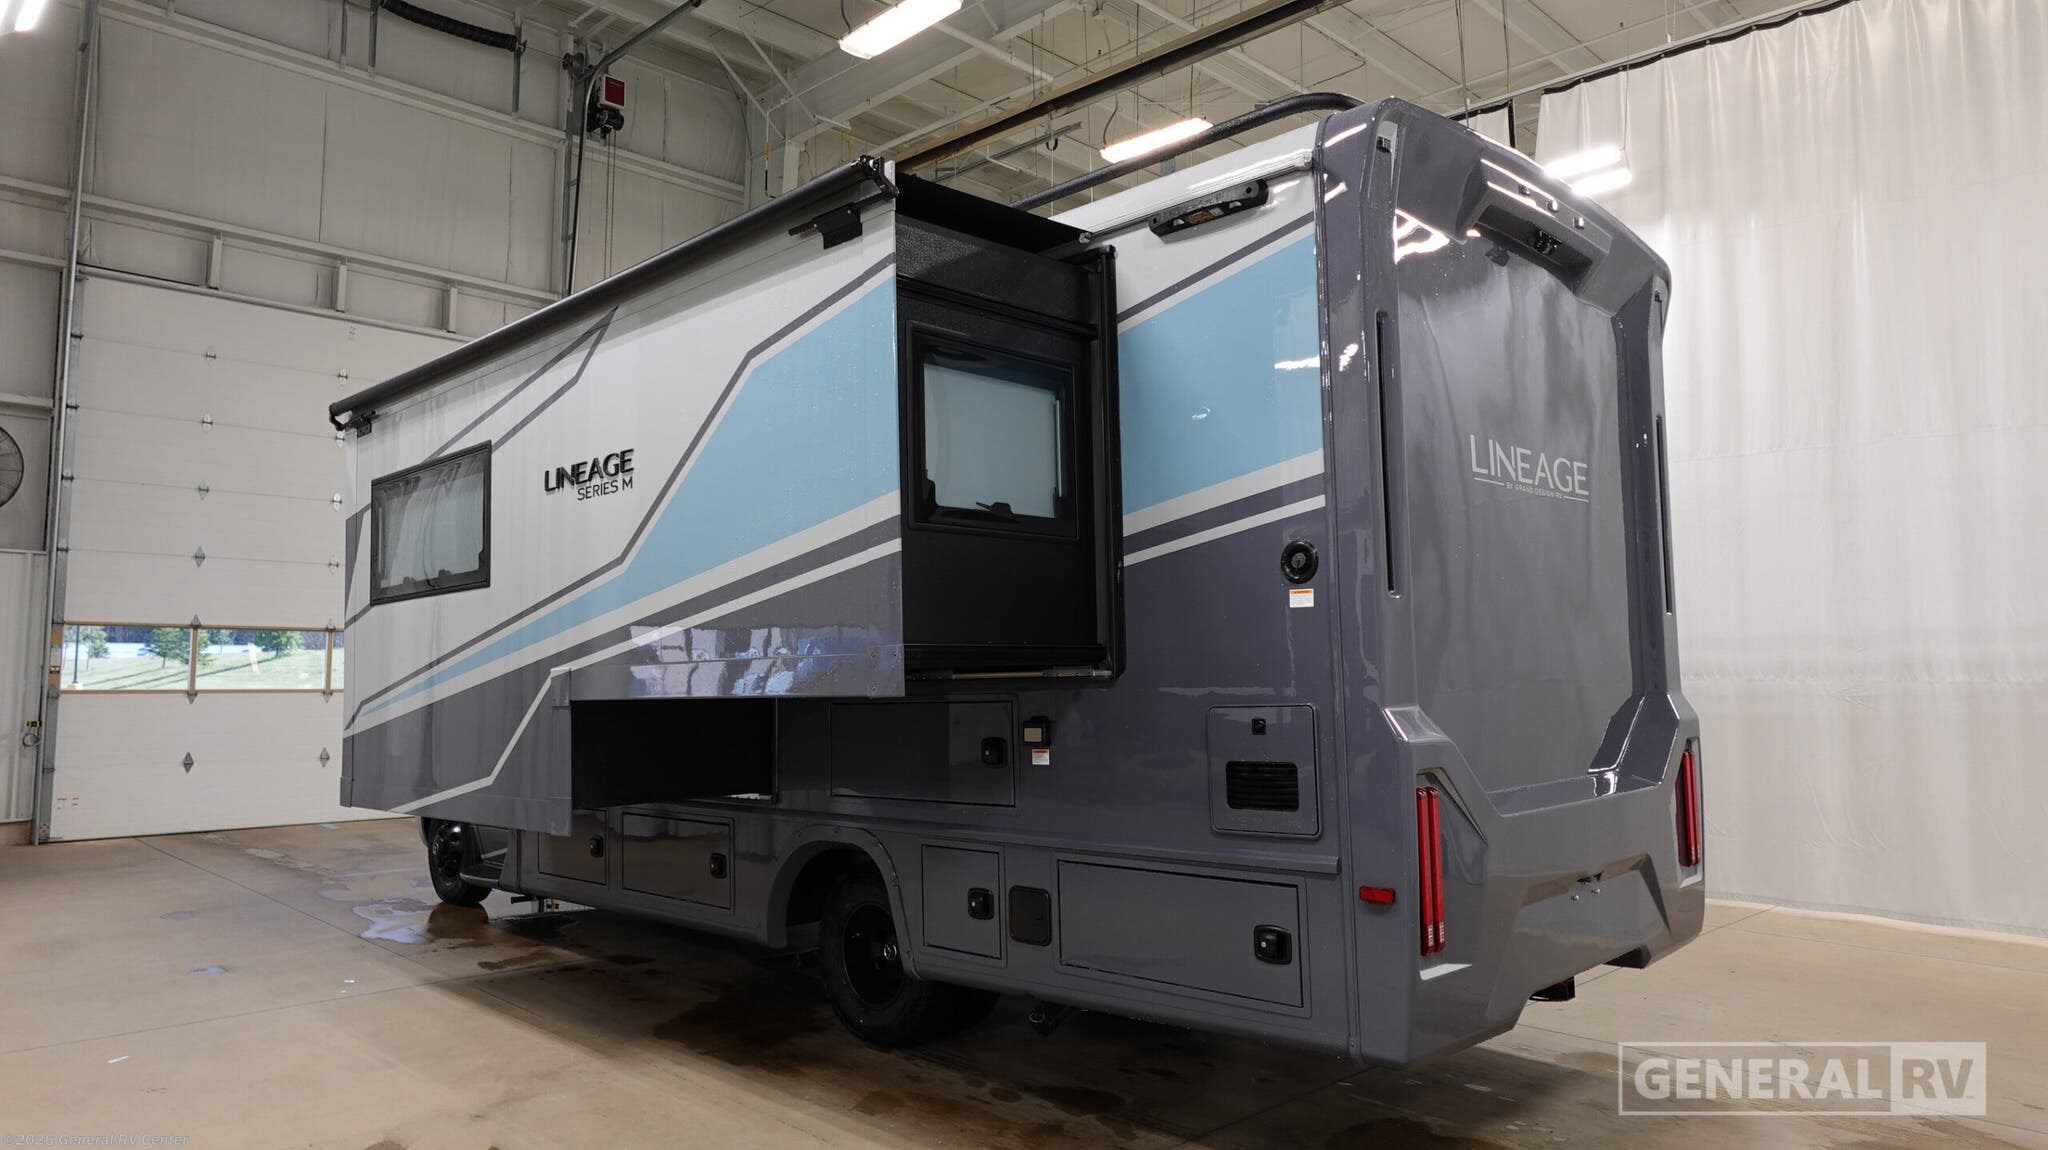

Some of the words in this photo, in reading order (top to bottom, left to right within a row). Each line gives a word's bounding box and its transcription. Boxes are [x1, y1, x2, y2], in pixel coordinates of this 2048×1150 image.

[544, 448, 634, 492] LINEAGE
[1470, 434, 1589, 496] LINEAGE
[577, 479, 619, 501] SERIES
[622, 476, 633, 491] M
